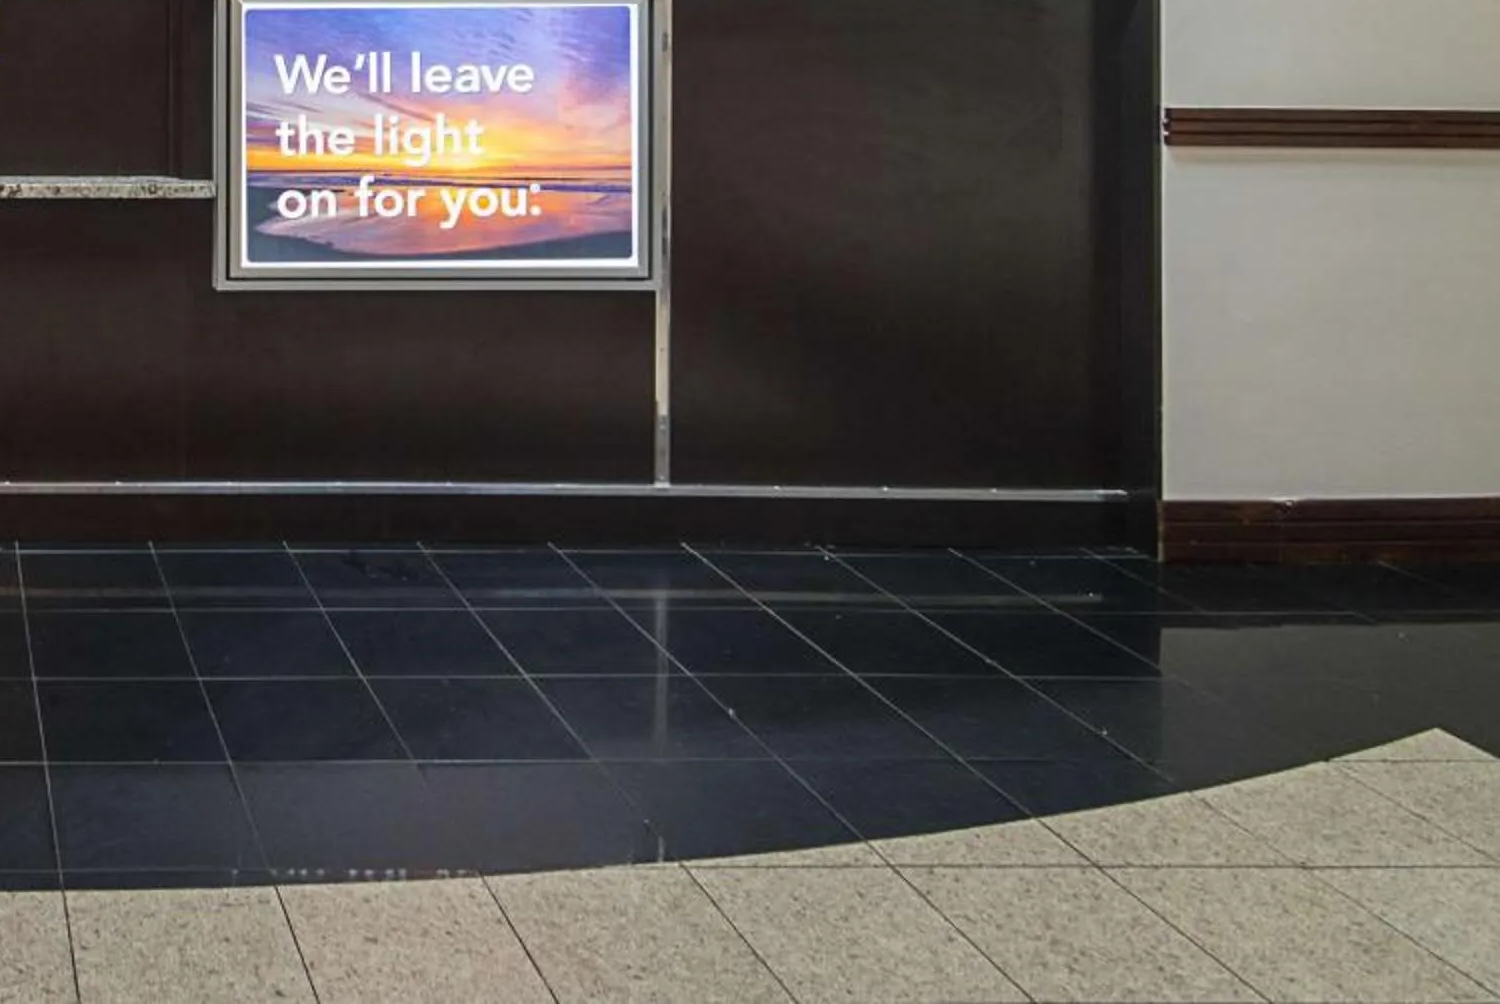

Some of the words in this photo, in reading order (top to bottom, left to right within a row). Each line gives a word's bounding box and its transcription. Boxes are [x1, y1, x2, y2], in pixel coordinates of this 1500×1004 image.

[274, 51, 391, 94] We'll
[411, 51, 535, 93] leave
[276, 114, 355, 157] the
[374, 113, 485, 166] light
[277, 188, 337, 219] on
[355, 175, 427, 217] for
